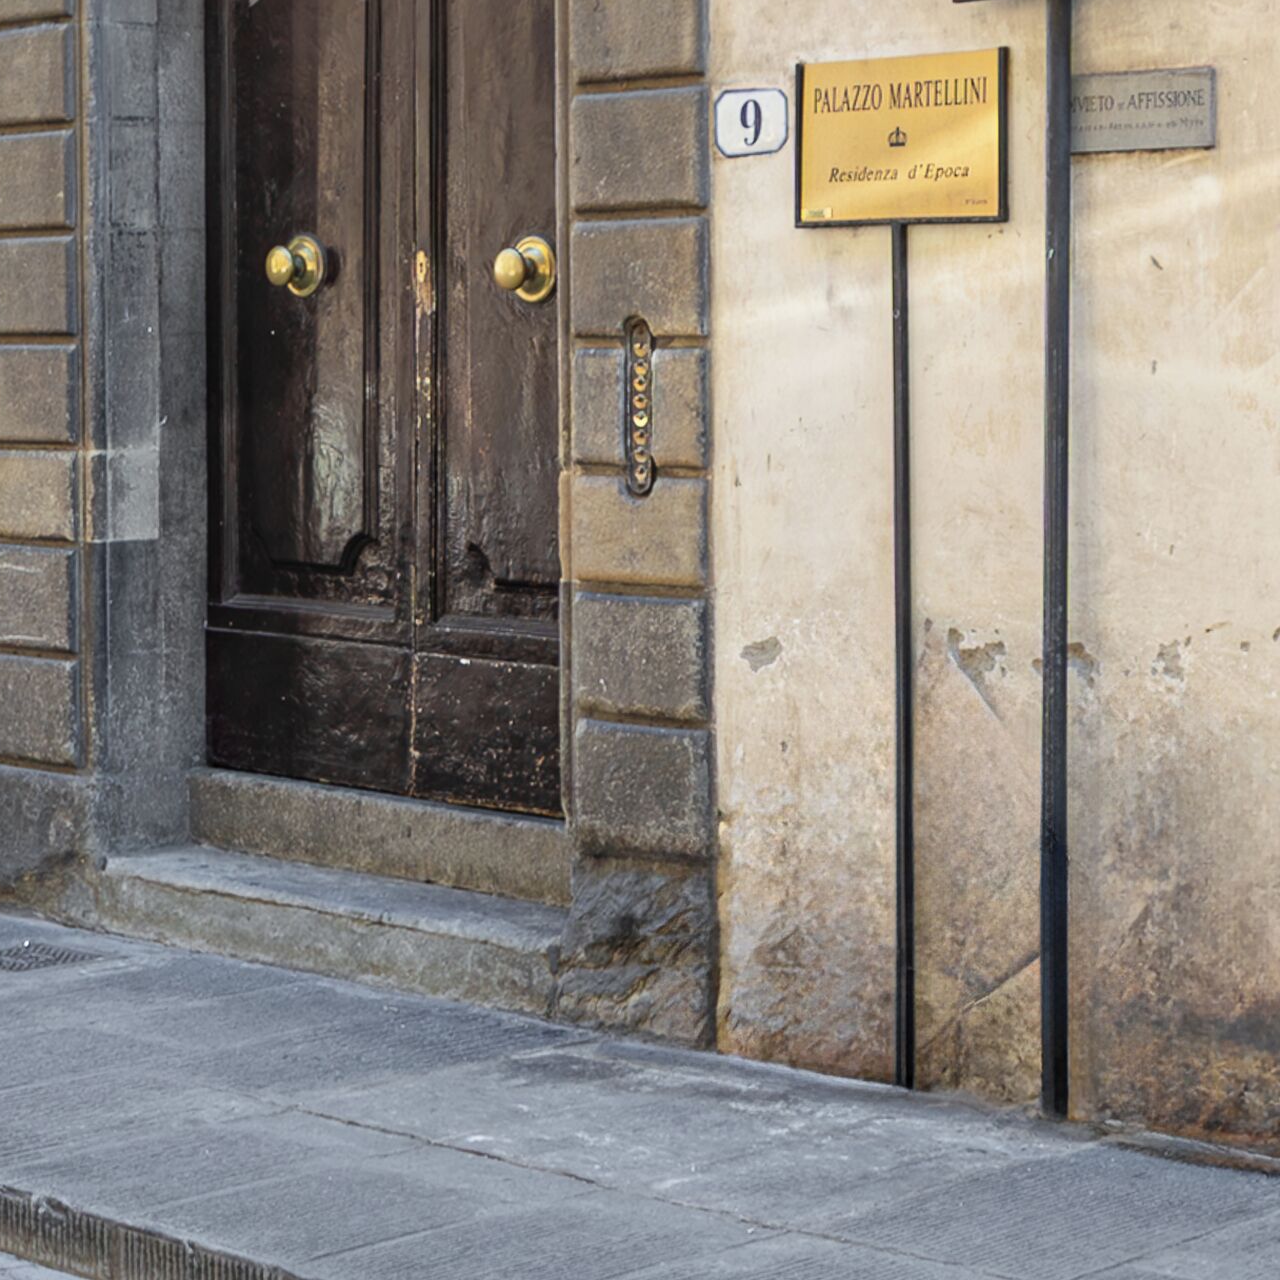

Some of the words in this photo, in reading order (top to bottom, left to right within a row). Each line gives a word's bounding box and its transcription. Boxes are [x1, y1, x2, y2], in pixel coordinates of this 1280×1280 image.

[814, 83, 883, 114] PALAZZO
[889, 76, 988, 110] MARTELLINI
[1127, 88, 1206, 110] AFFISSIONE
[740, 99, 762, 146] 9
[828, 165, 899, 183] Residenza
[908, 162, 970, 183] d'Epoca
